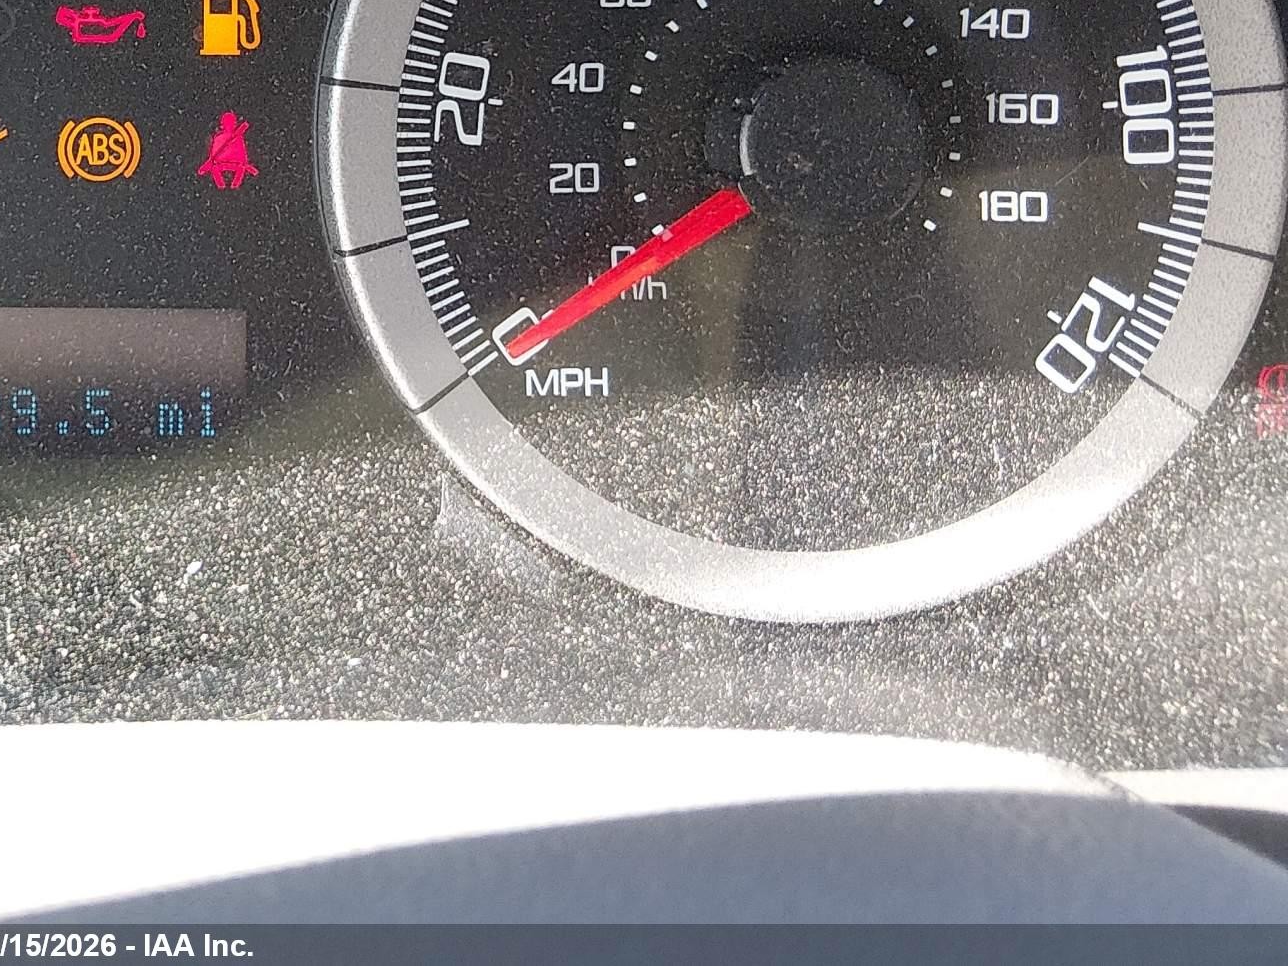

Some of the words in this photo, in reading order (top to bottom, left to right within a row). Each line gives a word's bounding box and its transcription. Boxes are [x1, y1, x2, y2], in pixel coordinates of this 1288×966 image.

[959, 8, 1030, 38] 140
[551, 63, 605, 93] 40
[434, 52, 490, 146] 20
[985, 95, 1058, 124] 160
[1115, 44, 1175, 165] 100
[75, 133, 124, 165] ABS
[549, 165, 600, 193] 20
[978, 192, 1049, 221] 180
[1035, 276, 1138, 394] 120
[525, 368, 609, 396] MPH
[158, 387, 215, 437] mi
